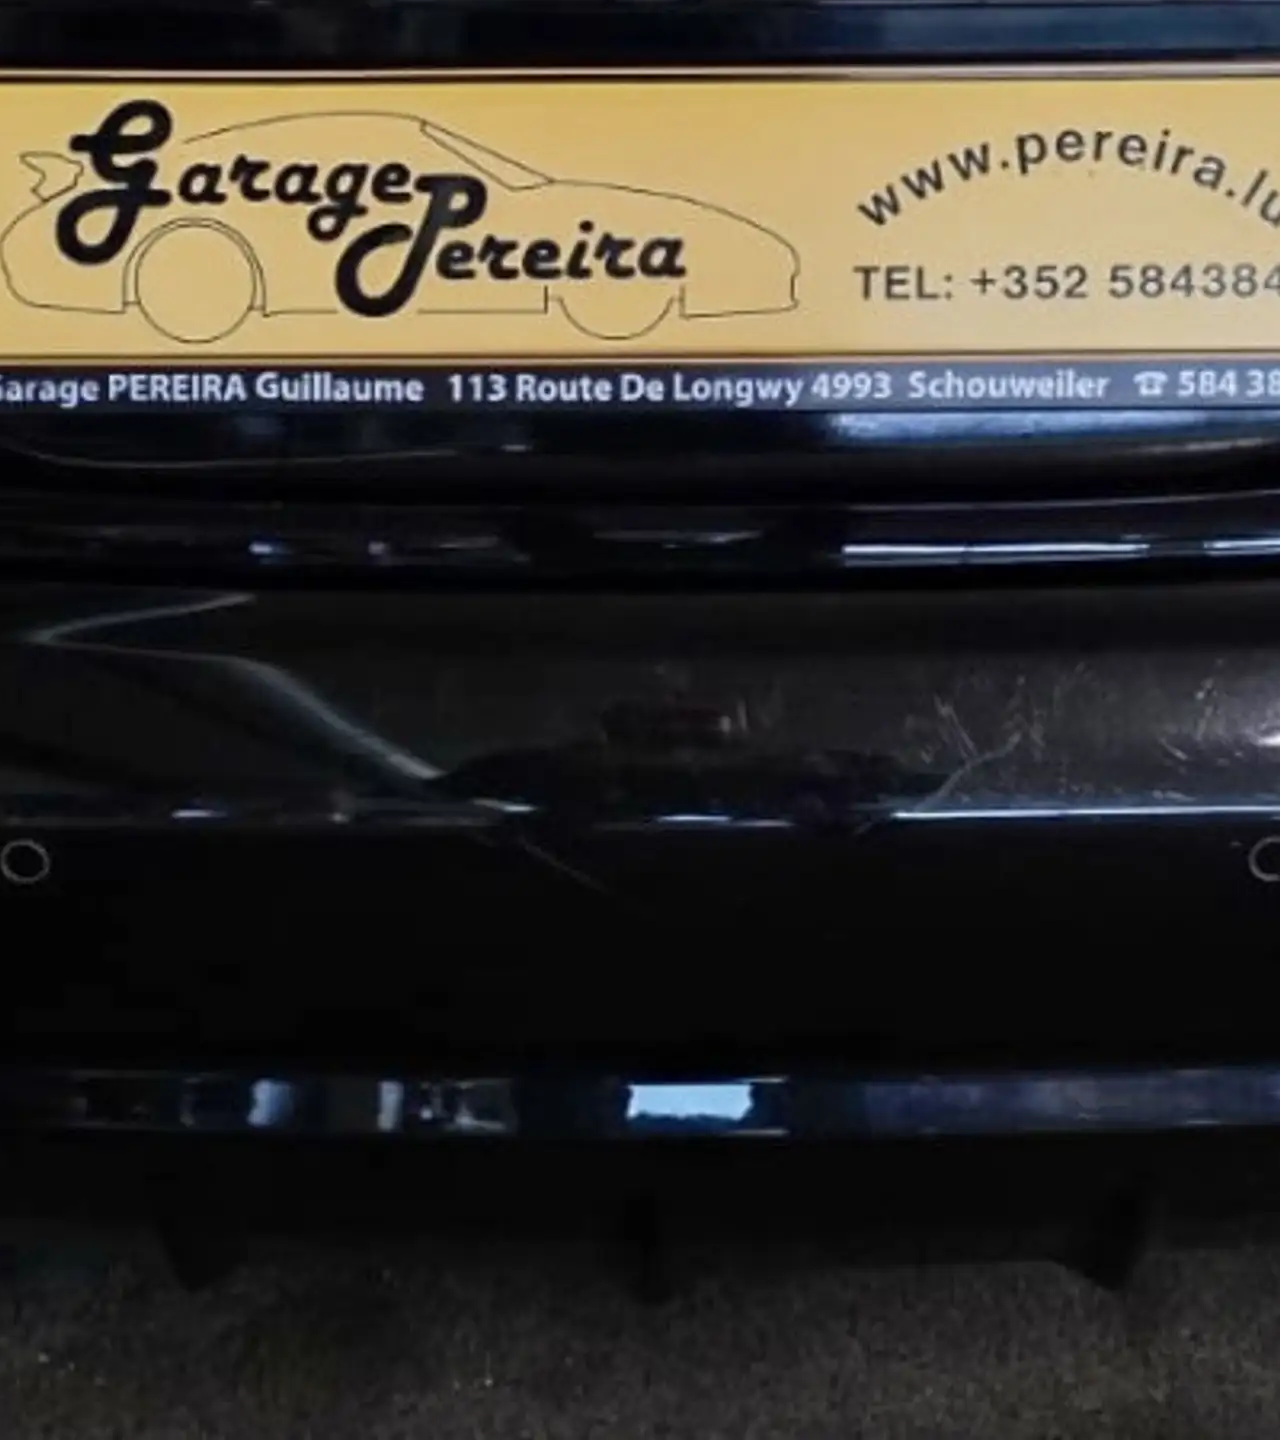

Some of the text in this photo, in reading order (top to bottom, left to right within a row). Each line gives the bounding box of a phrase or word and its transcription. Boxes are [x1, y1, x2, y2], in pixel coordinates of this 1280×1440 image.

[55, 98, 413, 266] Garage
[334, 173, 687, 318] Pereira
[852, 264, 954, 301] TEL:
[969, 264, 1089, 300] +352
[108, 372, 248, 402] PEREIRA
[255, 370, 425, 402] Guillaume
[447, 373, 507, 402] 113
[515, 373, 612, 402] Route
[619, 373, 664, 402] De
[672, 372, 804, 408] Longwy
[811, 371, 893, 400] 4993
[908, 369, 1111, 400] Schouweiler
[1176, 368, 1237, 398] 584
